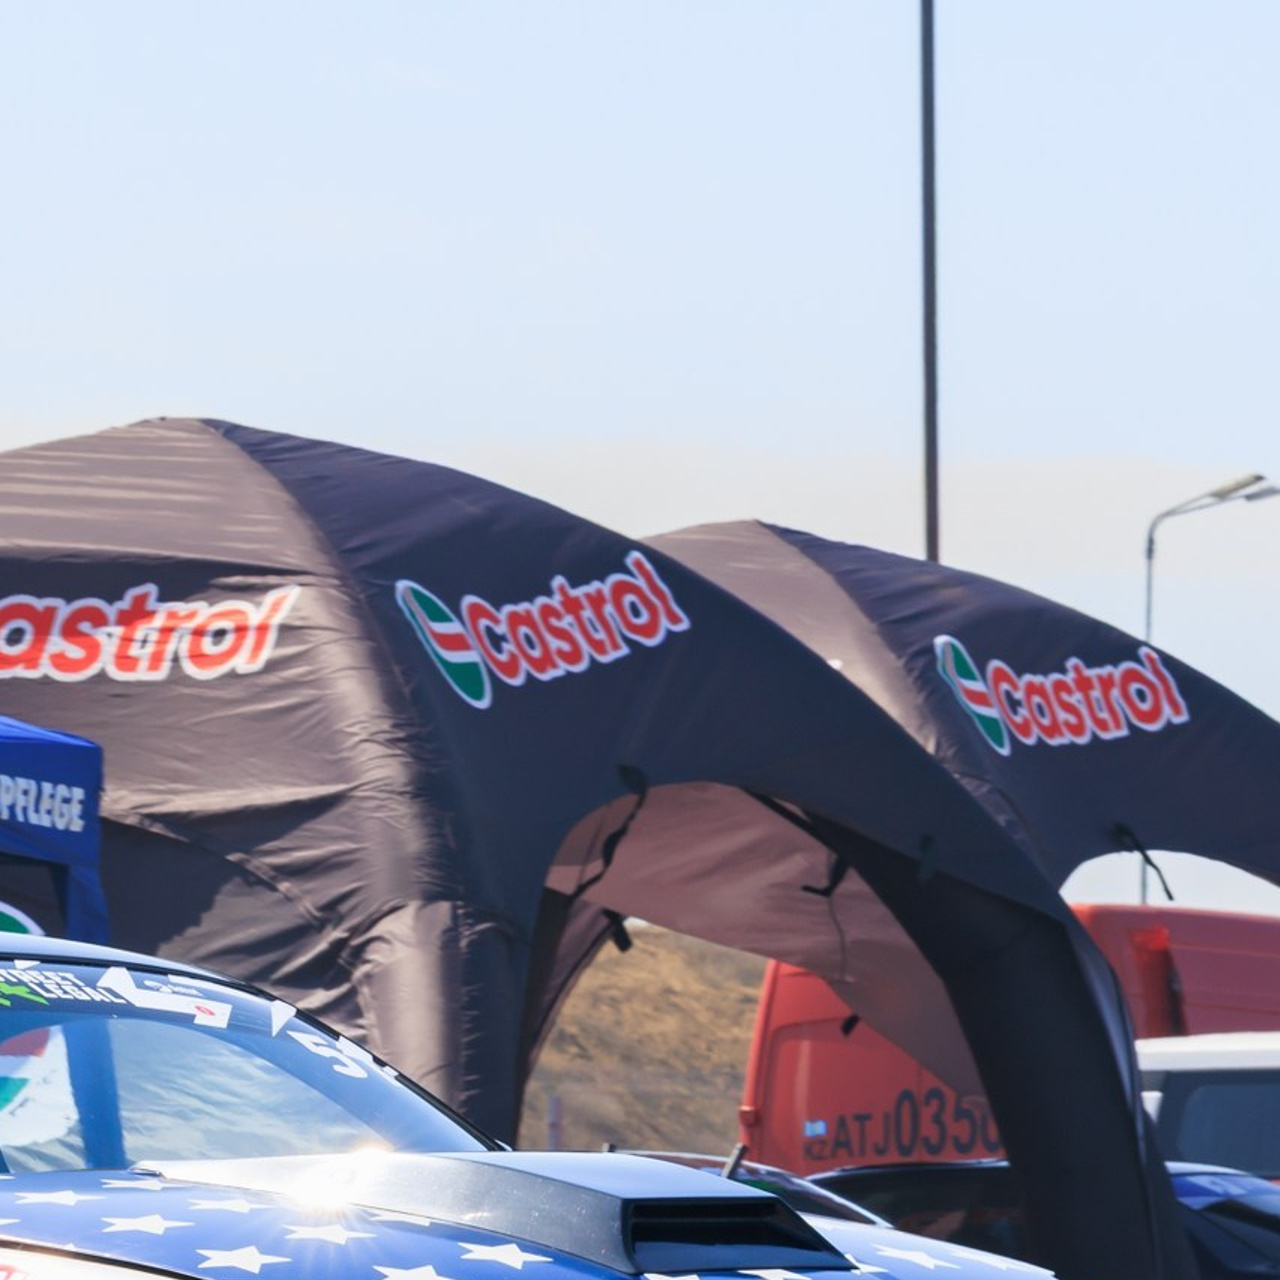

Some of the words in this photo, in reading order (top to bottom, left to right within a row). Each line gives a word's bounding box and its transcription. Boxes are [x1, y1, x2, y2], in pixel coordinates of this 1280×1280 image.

[461, 551, 690, 687] Castrol
[985, 646, 1190, 747] Castrol
[27, 981, 128, 1004] LEGAL
